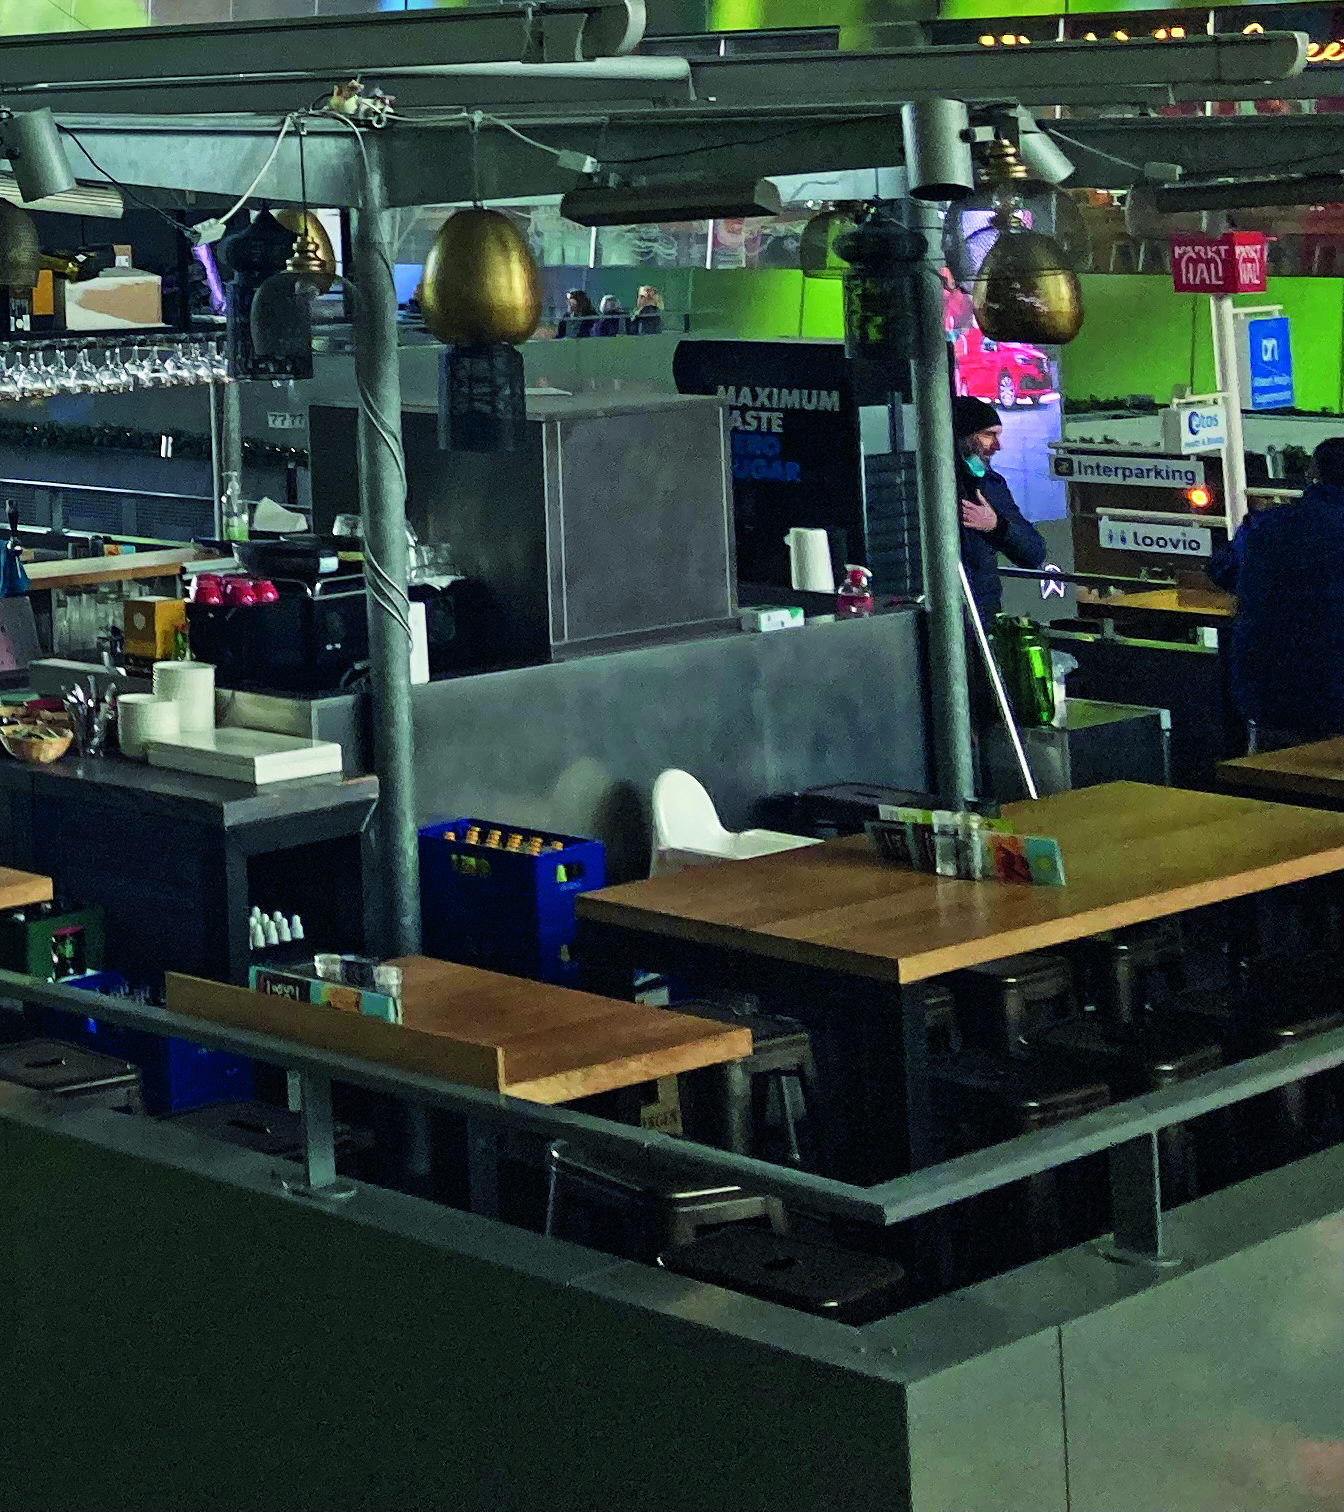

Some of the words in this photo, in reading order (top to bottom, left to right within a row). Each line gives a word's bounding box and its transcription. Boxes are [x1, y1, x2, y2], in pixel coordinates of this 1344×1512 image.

[717, 385, 841, 412] MAXIMUM
[729, 410, 784, 433] ASTE
[734, 434, 781, 457] ERO
[734, 456, 801, 482] UGAR
[1077, 460, 1197, 485] Interparking
[1133, 530, 1201, 551] loovio
